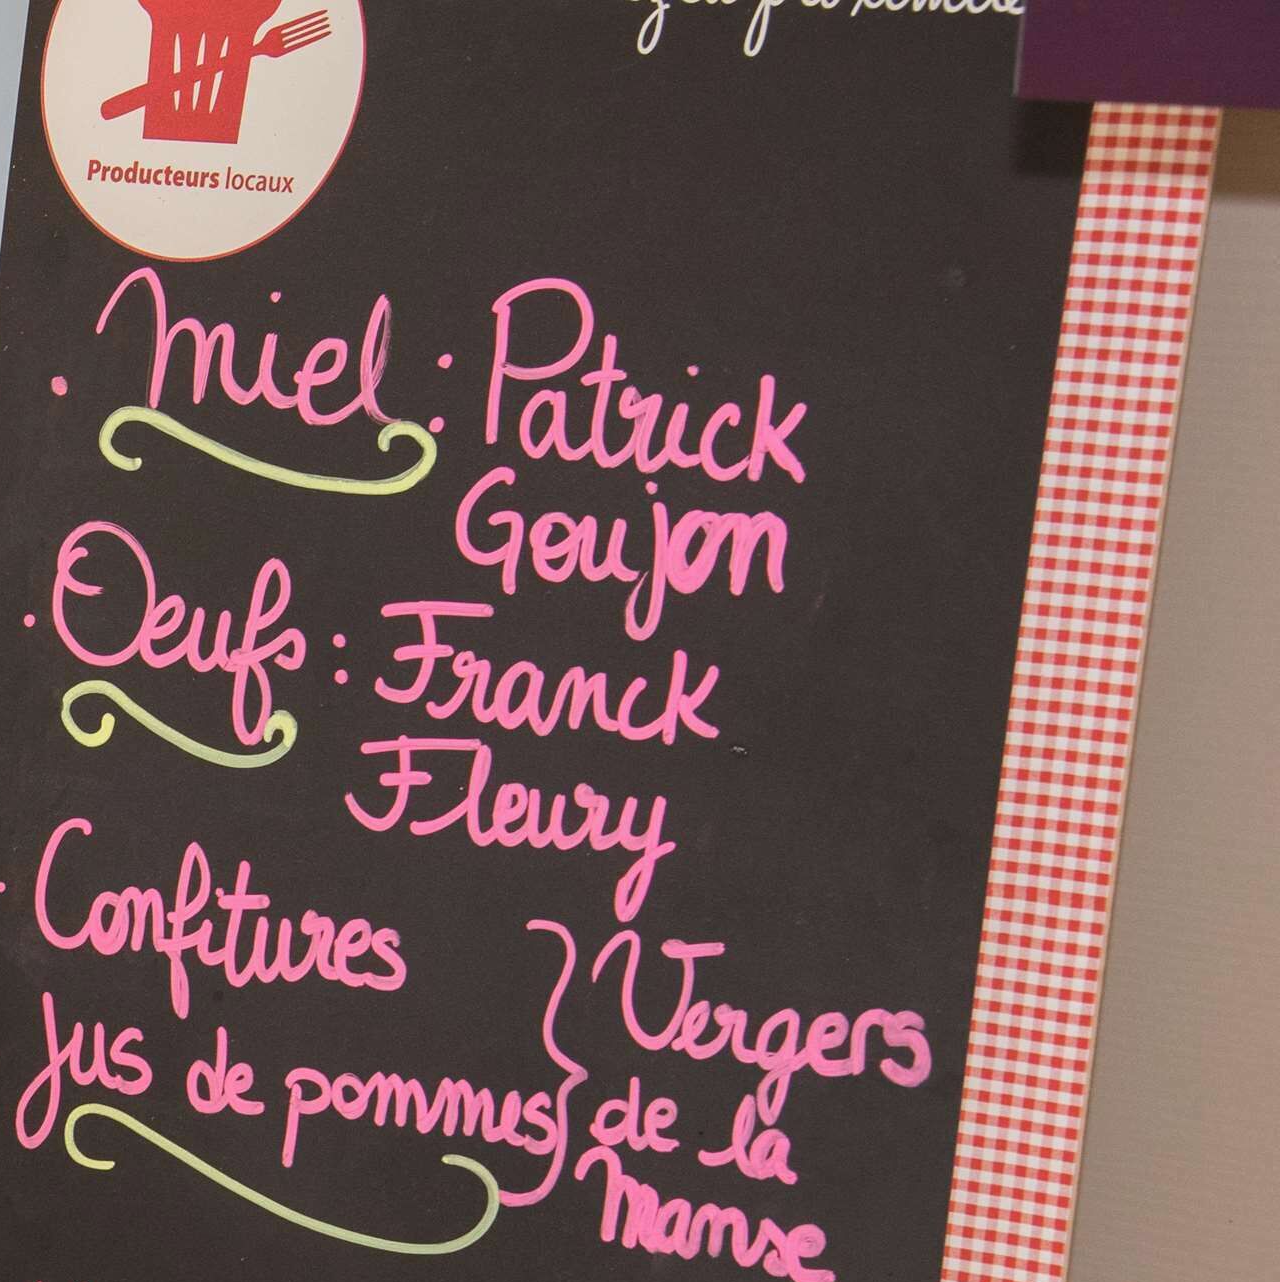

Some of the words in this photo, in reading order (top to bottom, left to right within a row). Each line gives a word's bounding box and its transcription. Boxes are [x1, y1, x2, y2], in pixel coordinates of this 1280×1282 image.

[86, 159, 220, 190] Producteurs
[224, 166, 294, 194] locaux
[486, 277, 805, 483] Patrick
[455, 467, 788, 640] Goujon
[374, 601, 720, 745] Franck
[346, 737, 675, 920] Fleury
[35, 817, 408, 1018] Confitures
[16, 993, 152, 1149] Jus
[187, 1029, 264, 1117] de
[591, 929, 931, 1115] Vergers
[591, 1077, 679, 1154] de
[698, 1096, 797, 1185] la
